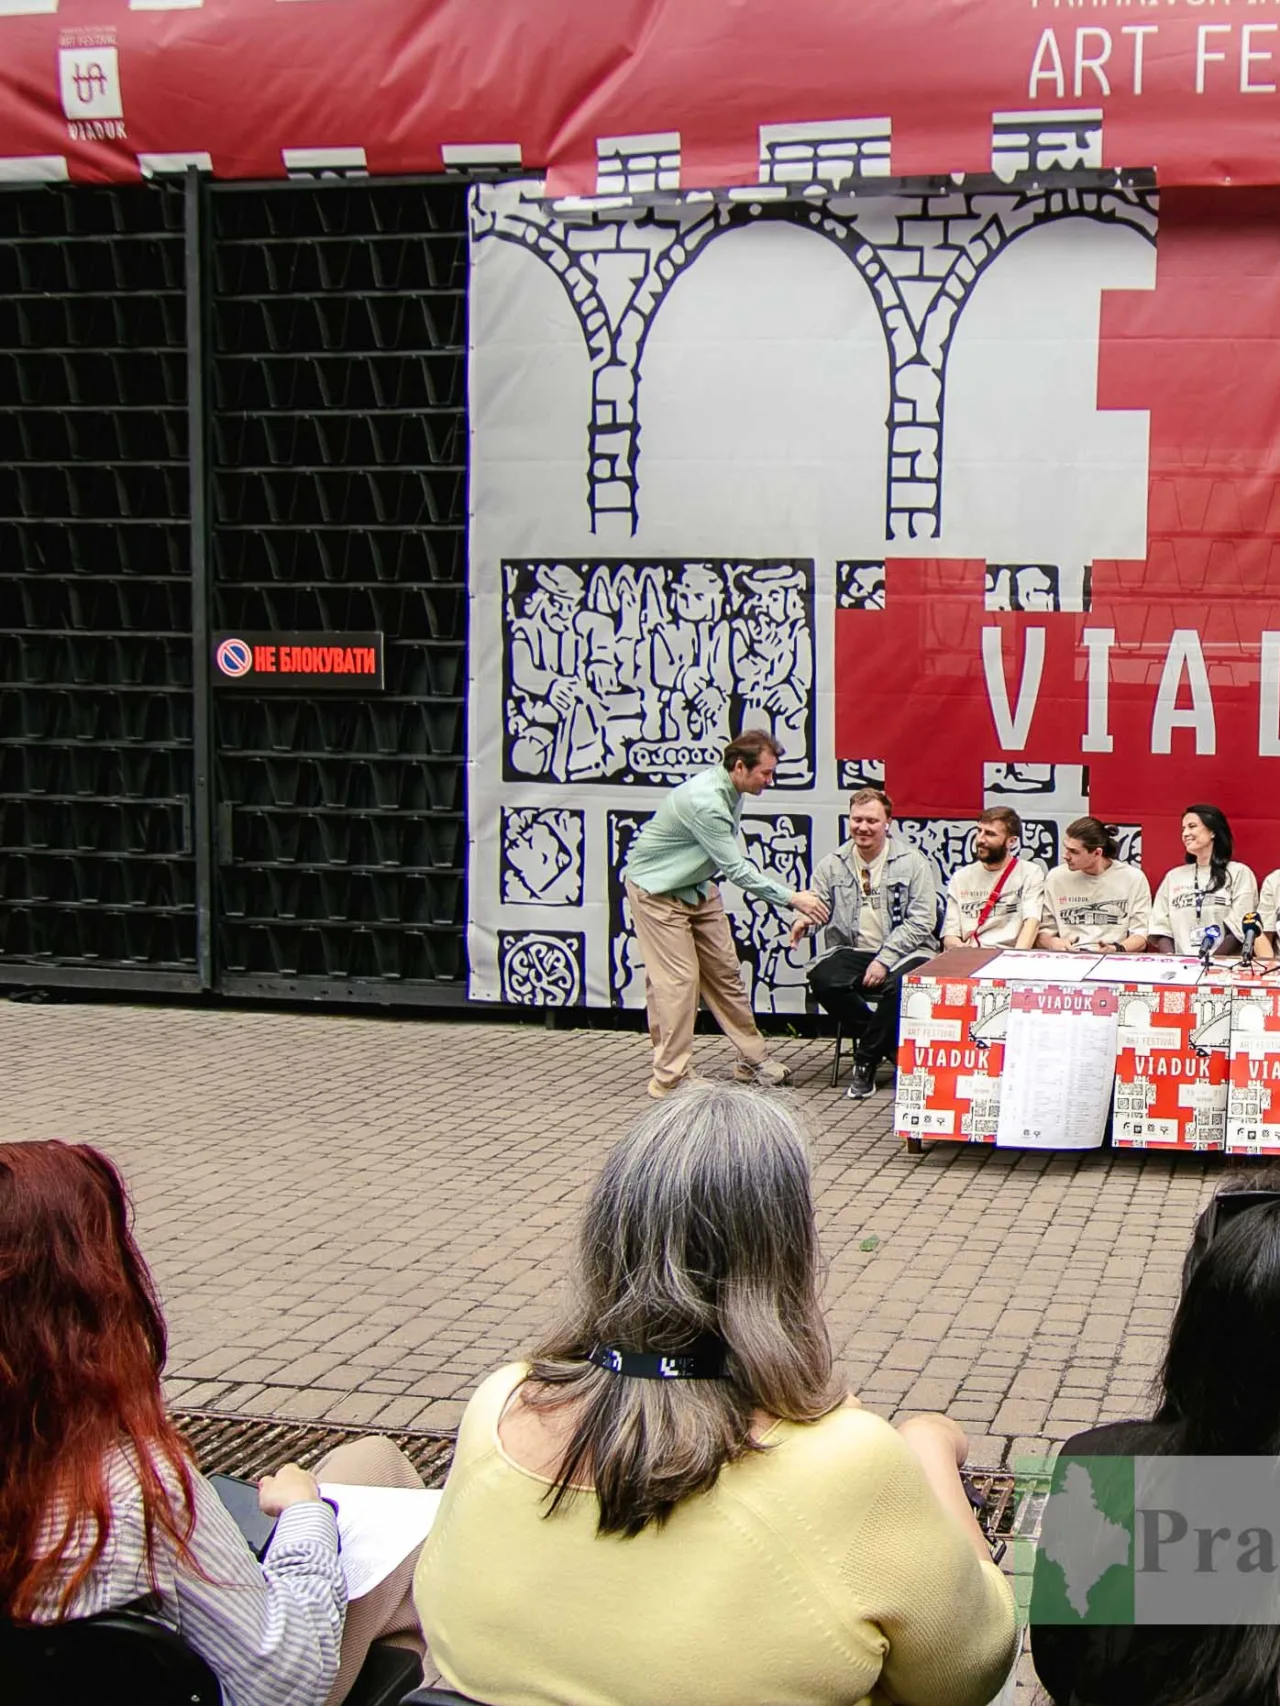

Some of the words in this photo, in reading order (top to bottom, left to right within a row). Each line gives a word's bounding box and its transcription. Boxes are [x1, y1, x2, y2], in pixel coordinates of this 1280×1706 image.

[1028, 25, 1158, 98] ART
[67, 119, 128, 141] VIADUK
[254, 646, 276, 672] НЕ
[280, 646, 375, 674] БЛОКУВАТИ
[1037, 996, 1092, 1010] VIADUK
[914, 1048, 989, 1069] VIADUK
[1135, 1055, 1211, 1078] VIADUK
